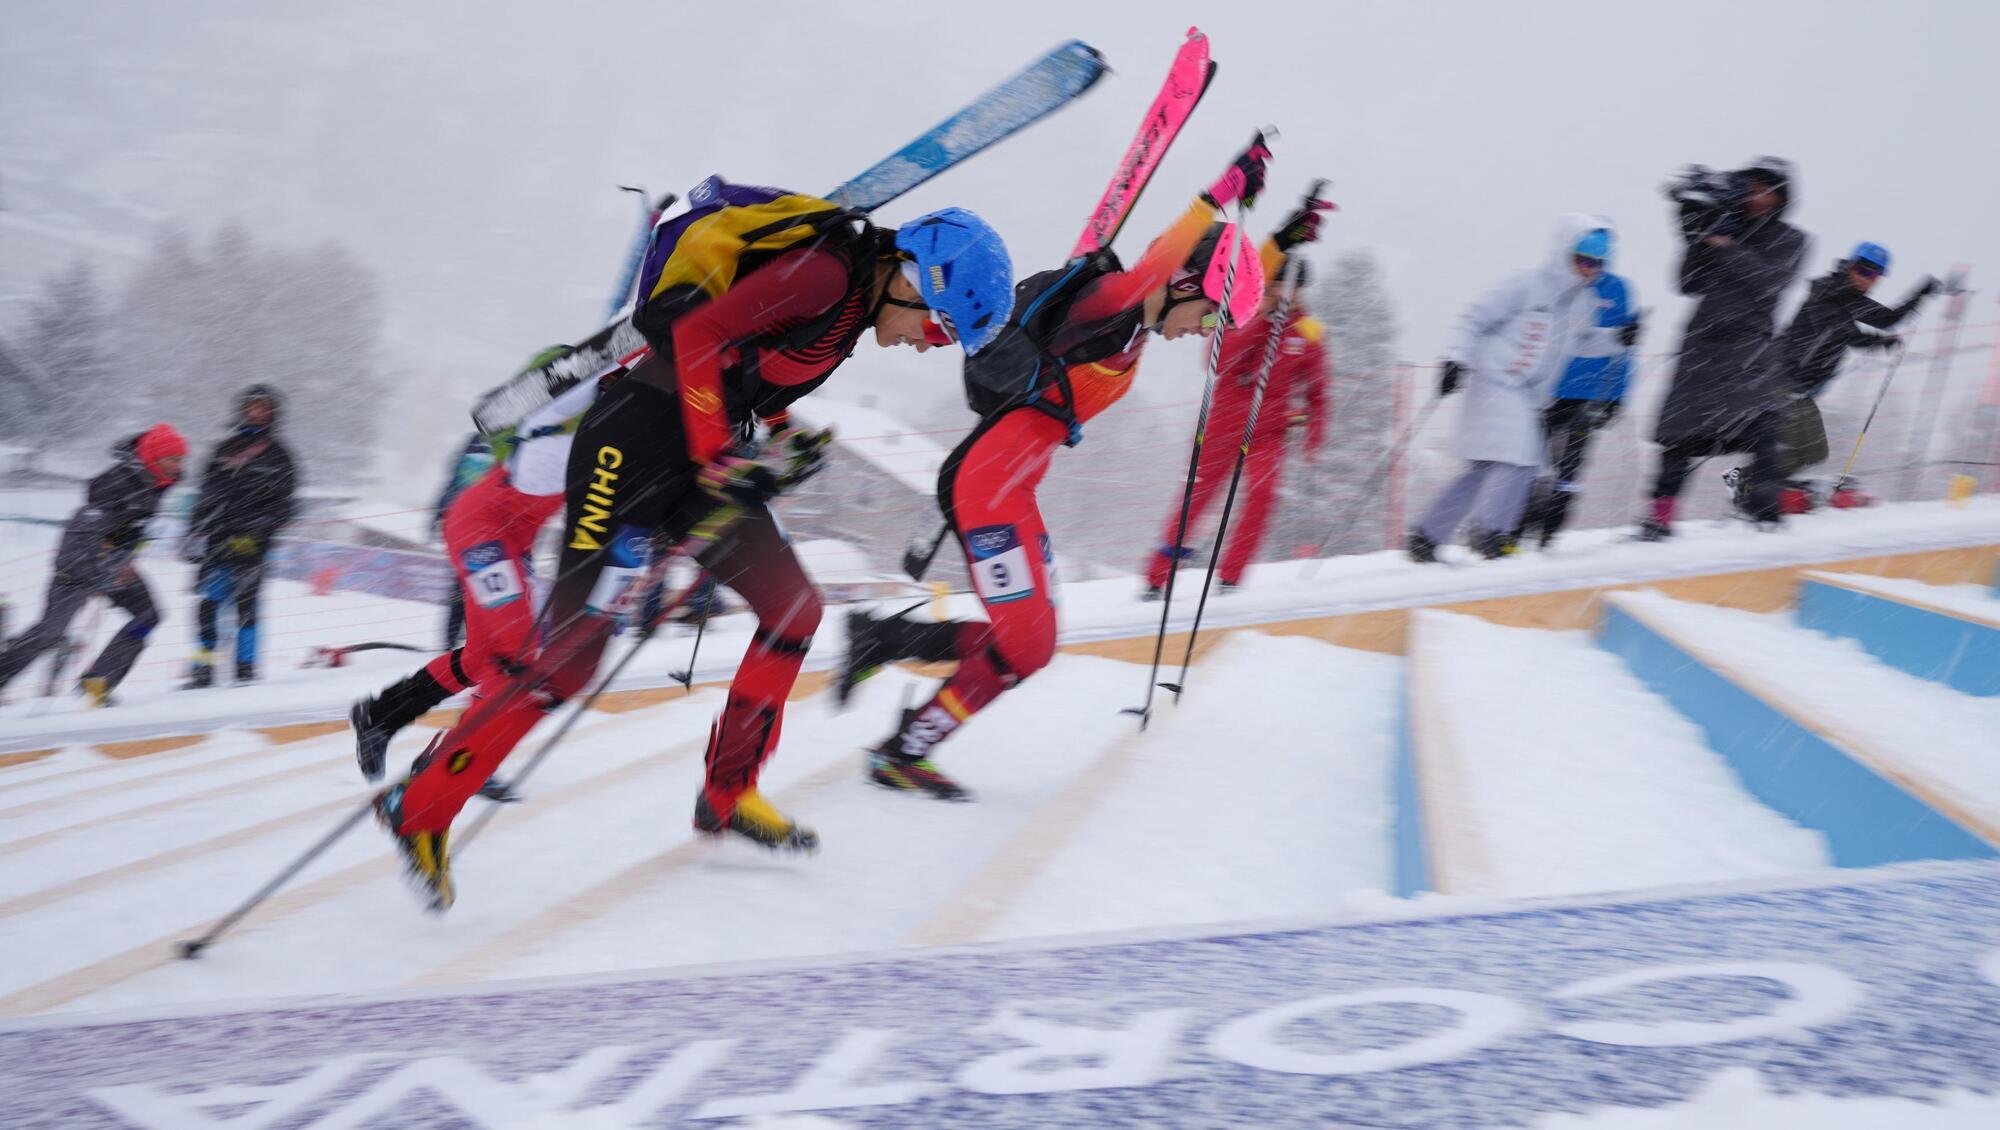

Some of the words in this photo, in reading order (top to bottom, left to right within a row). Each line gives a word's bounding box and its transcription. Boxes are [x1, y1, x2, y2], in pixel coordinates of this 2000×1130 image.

[568, 445, 624, 550] CHINA
[989, 562, 1010, 589] 9
[85, 961, 1862, 1130] CORTINA
